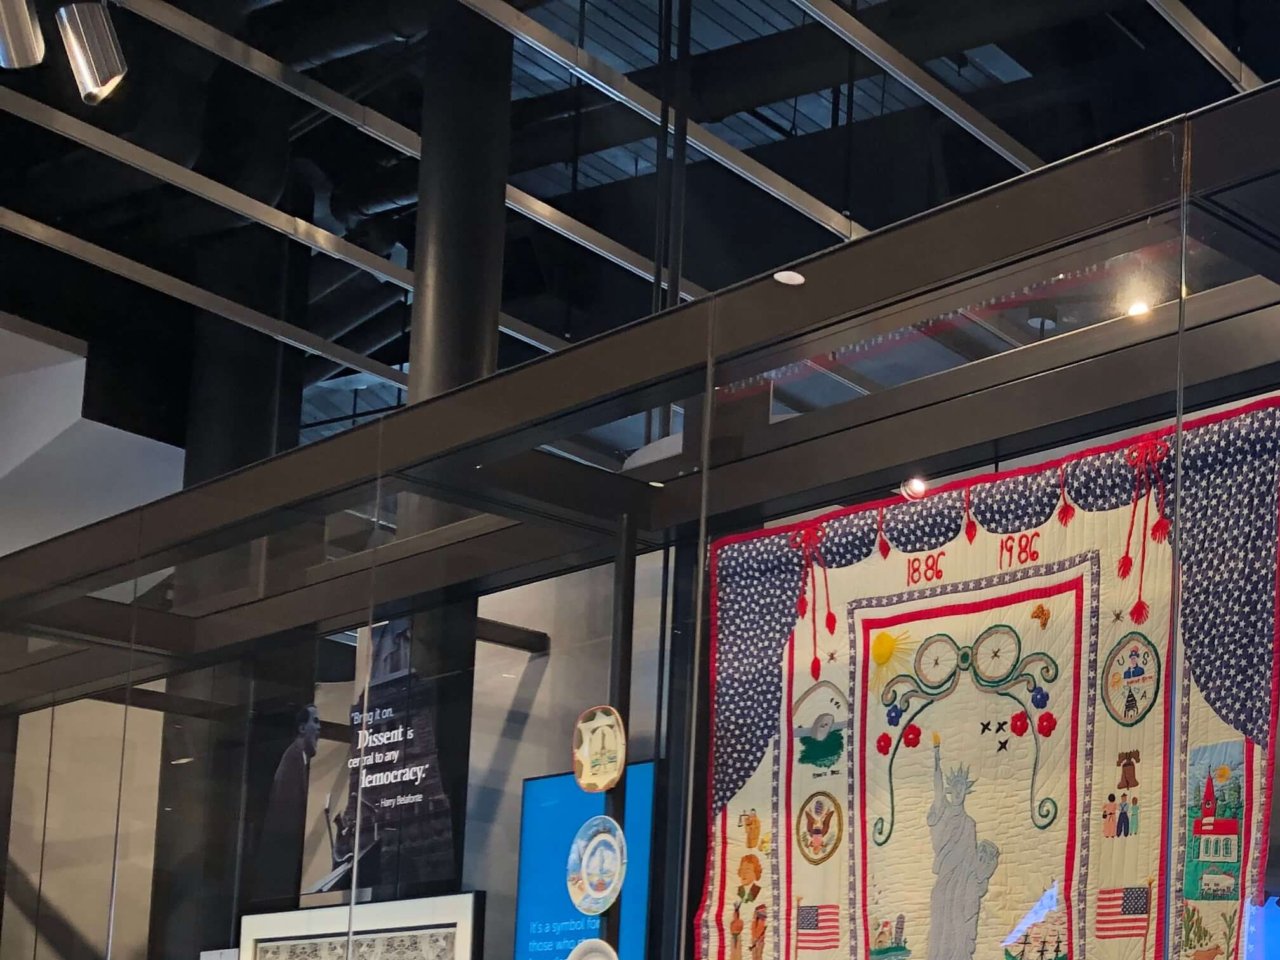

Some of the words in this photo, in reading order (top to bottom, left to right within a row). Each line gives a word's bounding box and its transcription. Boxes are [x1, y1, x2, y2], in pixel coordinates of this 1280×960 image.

[907, 551, 946, 587] 1886
[1000, 531, 1041, 571] 1986
[351, 711, 374, 725] "Brg
[356, 725, 404, 750] Dissent
[406, 727, 414, 739] is
[347, 752, 374, 768] cenral
[375, 752, 384, 764] to
[384, 750, 400, 764] any
